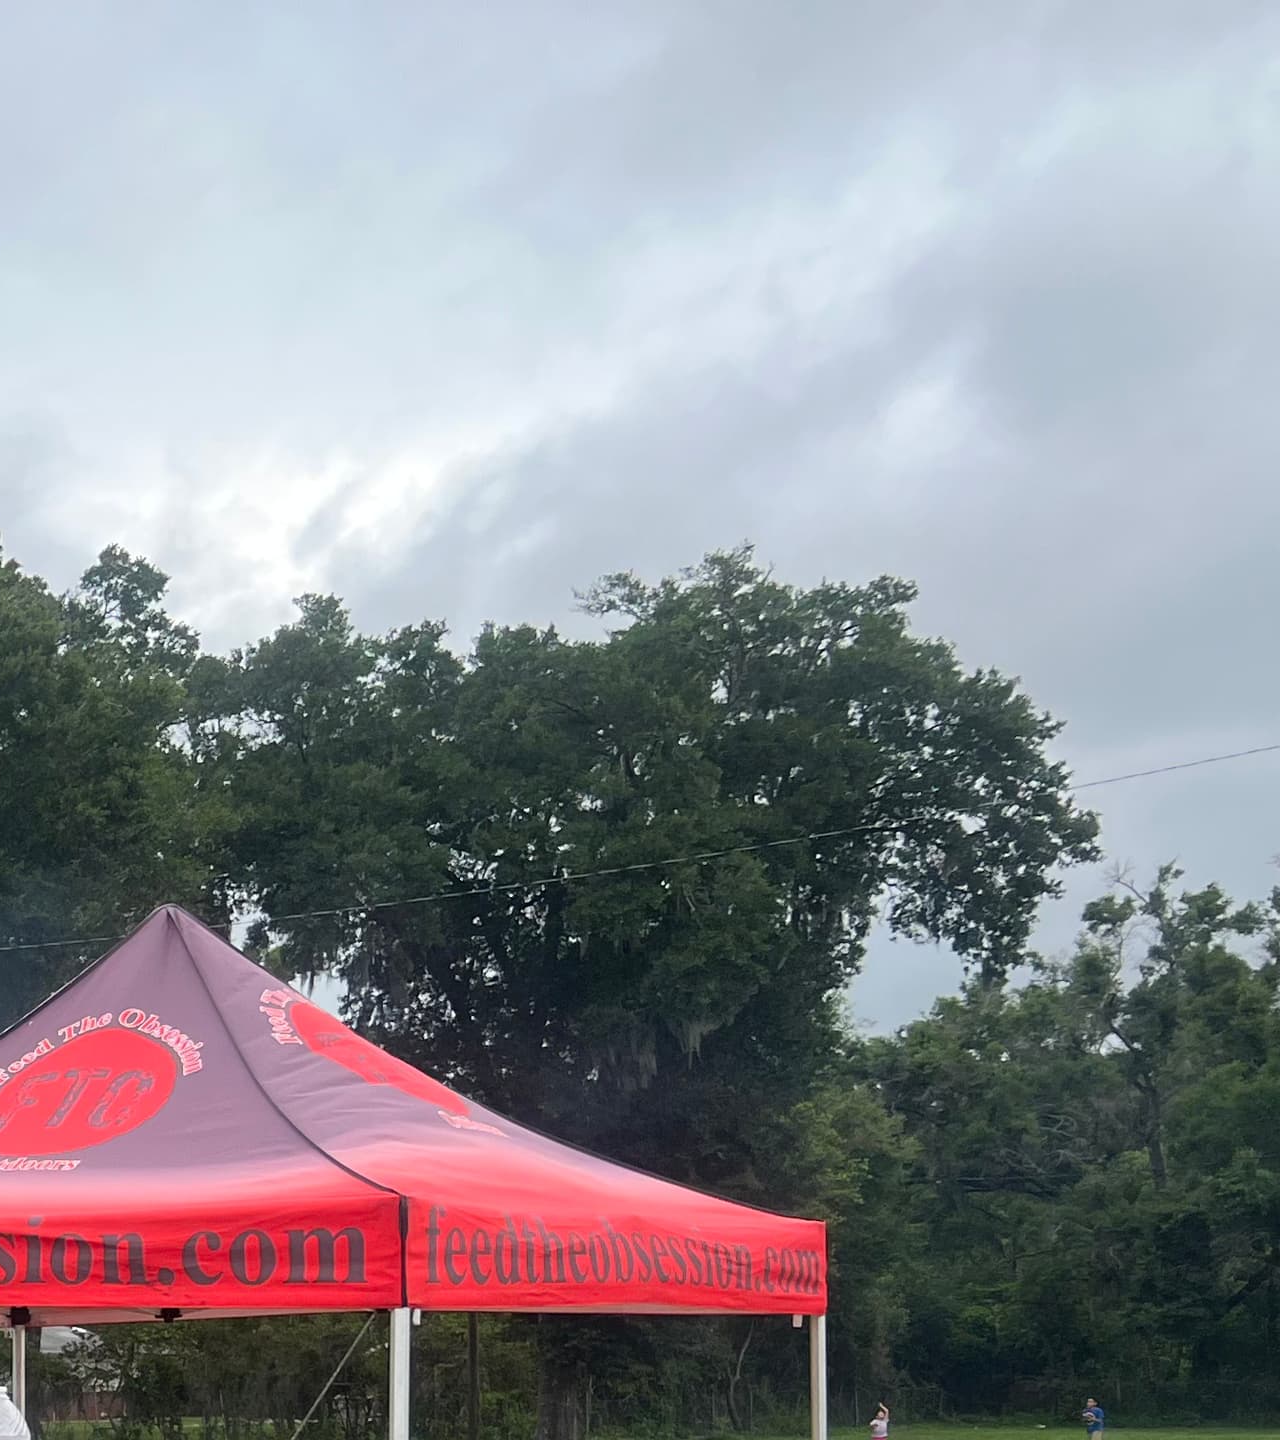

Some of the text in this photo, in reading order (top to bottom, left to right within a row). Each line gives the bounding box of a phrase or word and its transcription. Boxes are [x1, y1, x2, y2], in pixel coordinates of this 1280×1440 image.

[57, 1012, 113, 1042] The
[118, 1007, 204, 1076] Obsession
[425, 1204, 820, 1294] feedtheobsession.com
